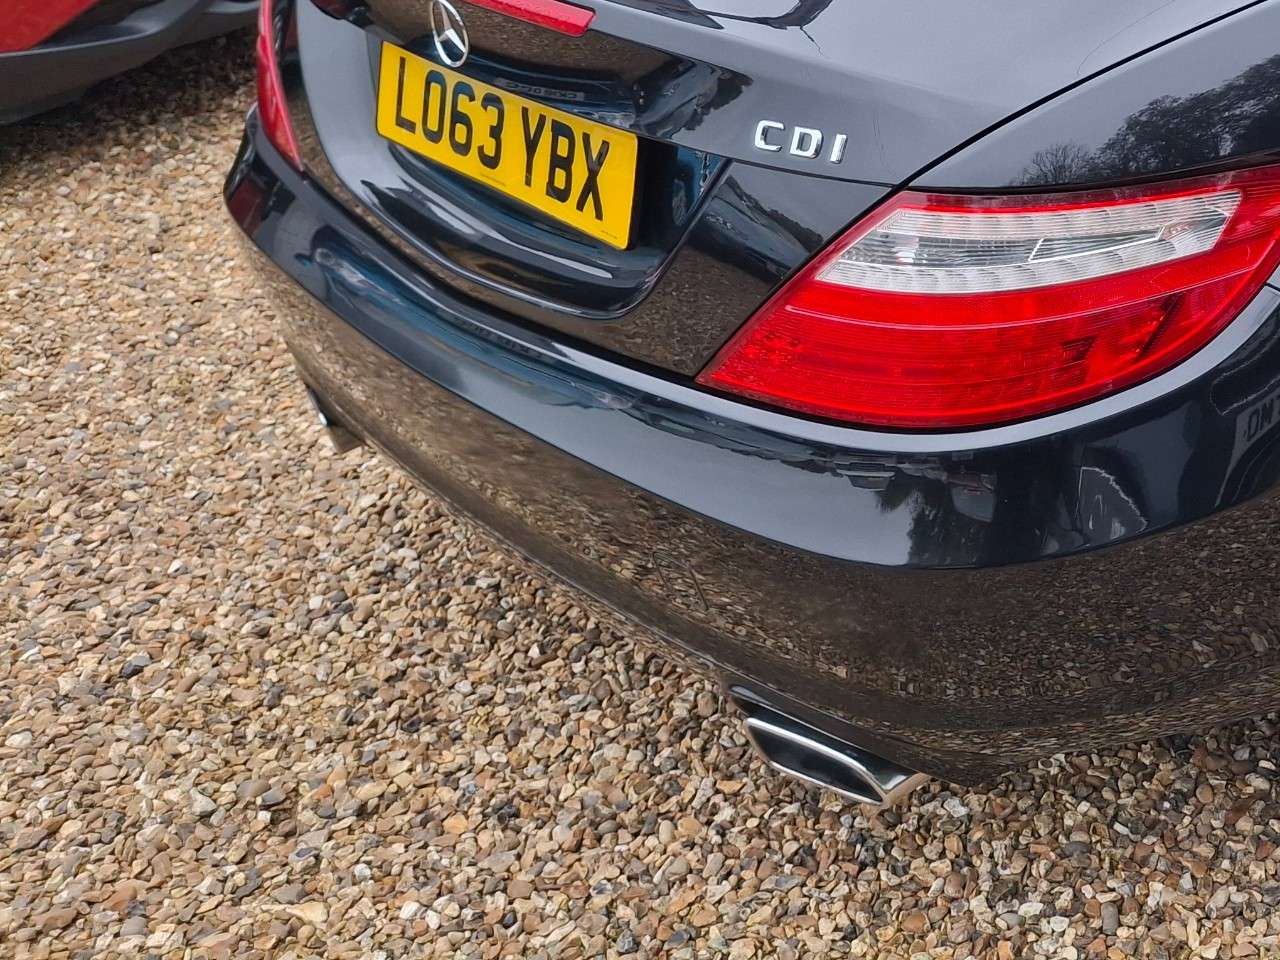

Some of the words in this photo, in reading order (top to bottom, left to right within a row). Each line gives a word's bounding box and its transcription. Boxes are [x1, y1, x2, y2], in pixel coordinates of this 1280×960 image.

[395, 56, 505, 170] LO63
[521, 106, 610, 221] YBX
[755, 120, 848, 164] CDI
